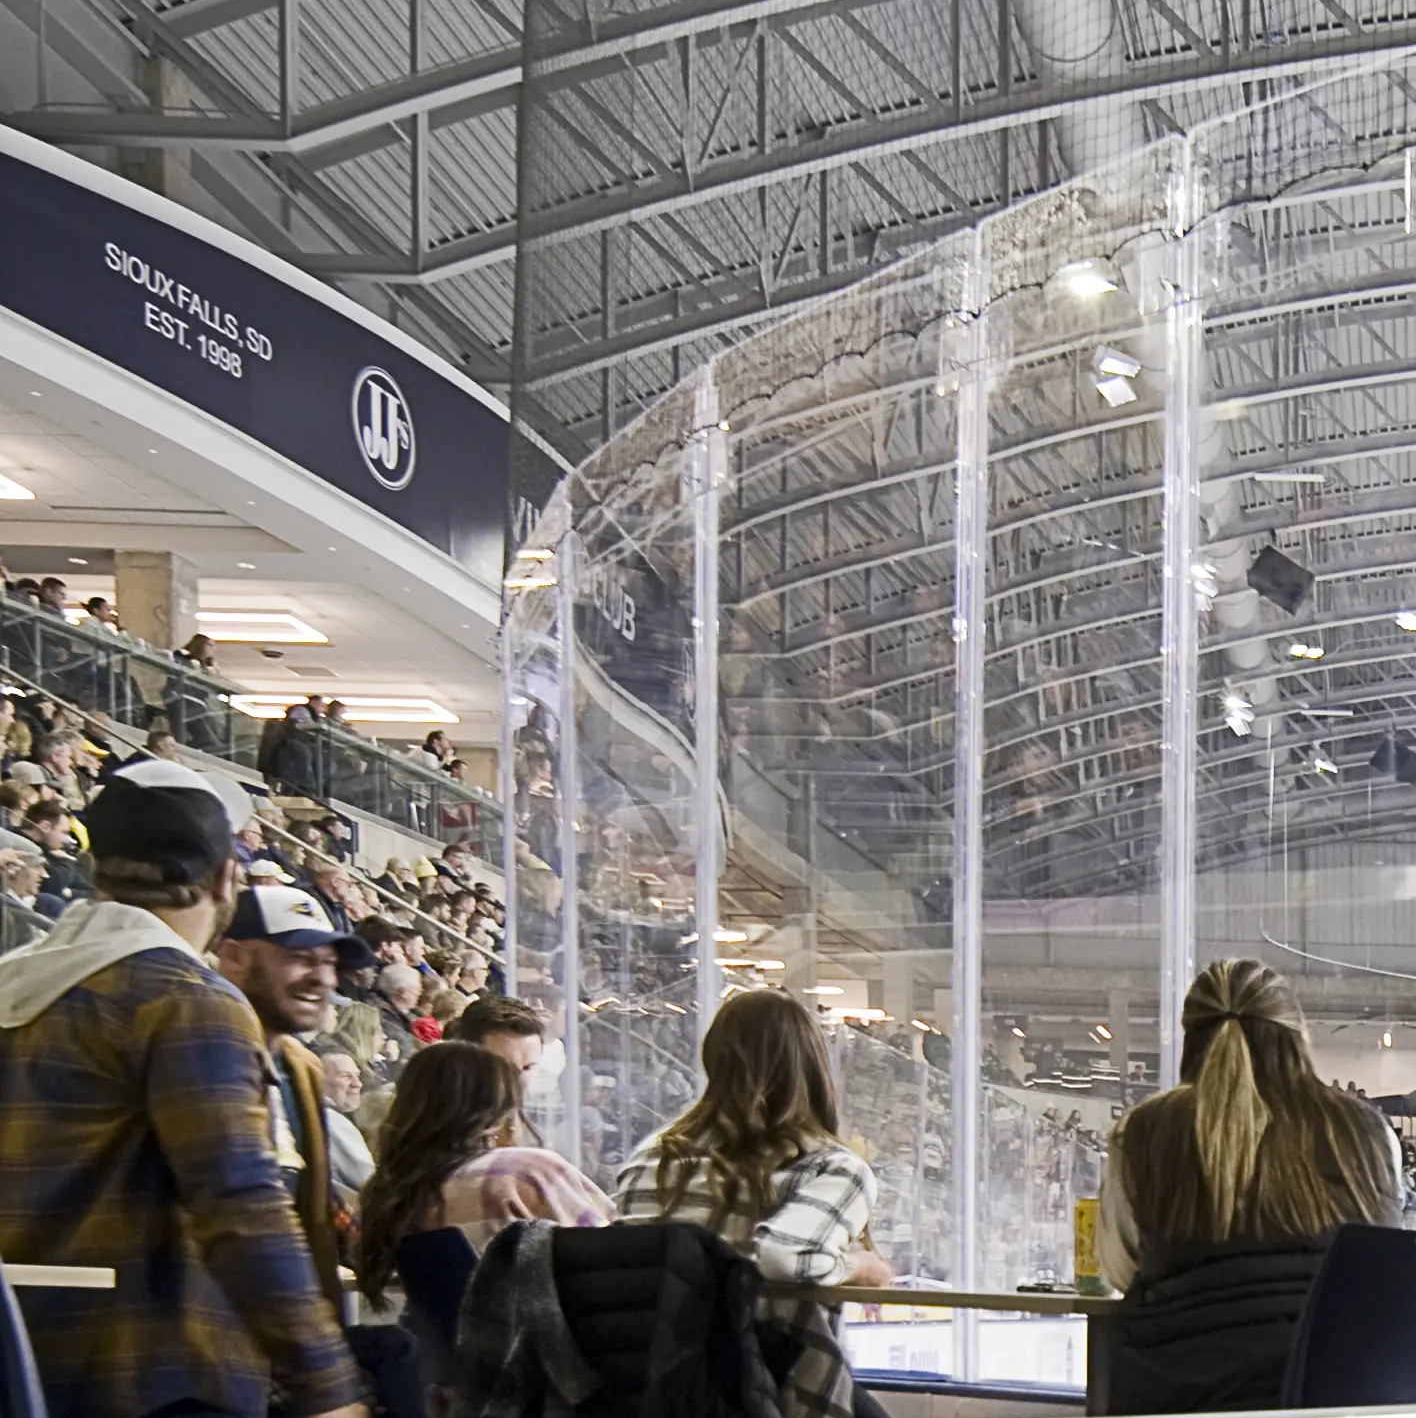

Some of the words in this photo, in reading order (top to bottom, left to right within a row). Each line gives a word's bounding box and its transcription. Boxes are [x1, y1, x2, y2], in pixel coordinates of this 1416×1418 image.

[104, 242, 175, 303] SIOUX
[176, 283, 244, 348] FALLS,
[245, 326, 272, 361] SD
[144, 301, 192, 350] EST.
[197, 334, 242, 378] 1998
